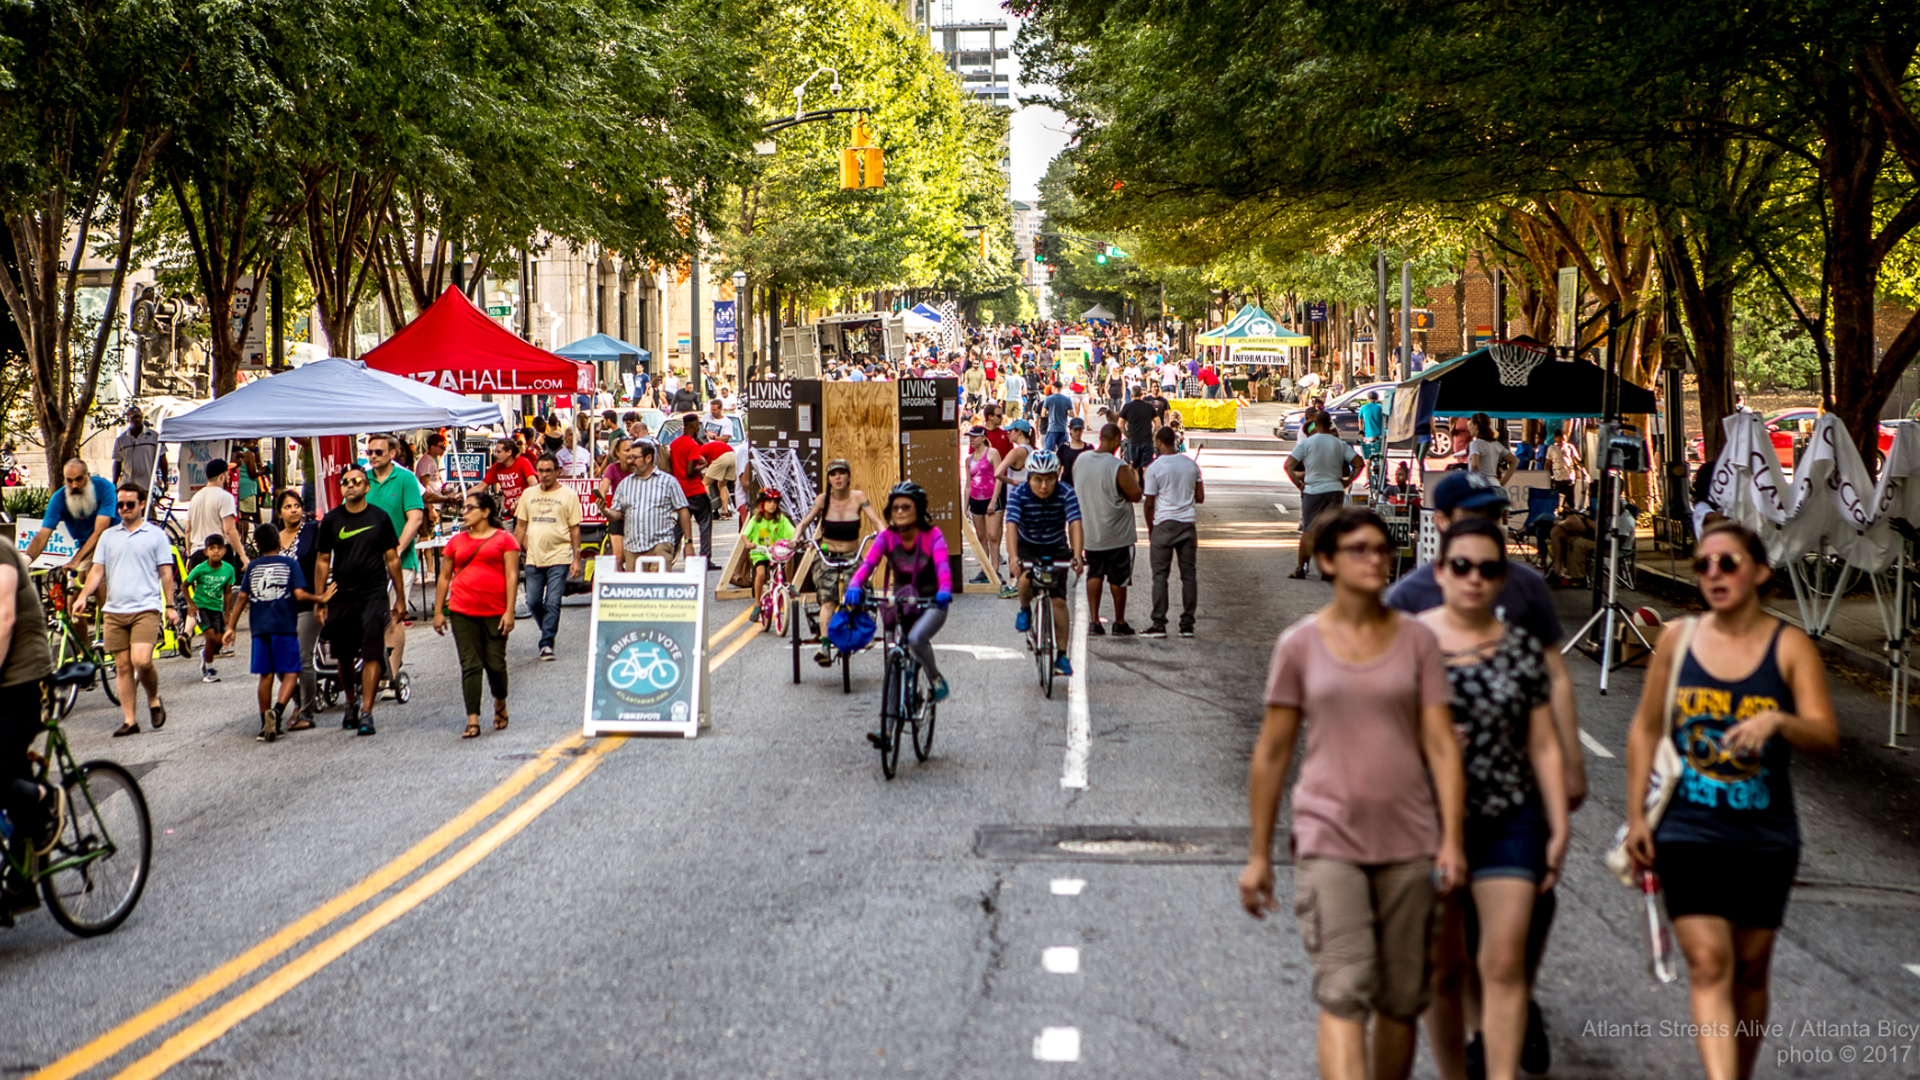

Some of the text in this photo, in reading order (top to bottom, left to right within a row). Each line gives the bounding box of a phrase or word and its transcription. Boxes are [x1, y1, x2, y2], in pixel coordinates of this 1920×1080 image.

[1232, 354, 1286, 364] INFORMATION
[749, 382, 792, 399] LIVING
[901, 380, 937, 397] LIVING
[749, 400, 792, 409] INFOGRAPHIC
[901, 397, 937, 406] INFOGRAPHIC
[600, 586, 697, 599] CANDIDATE ROW
[611, 631, 639, 655] BIKE
[657, 632, 683, 661] VOTE
